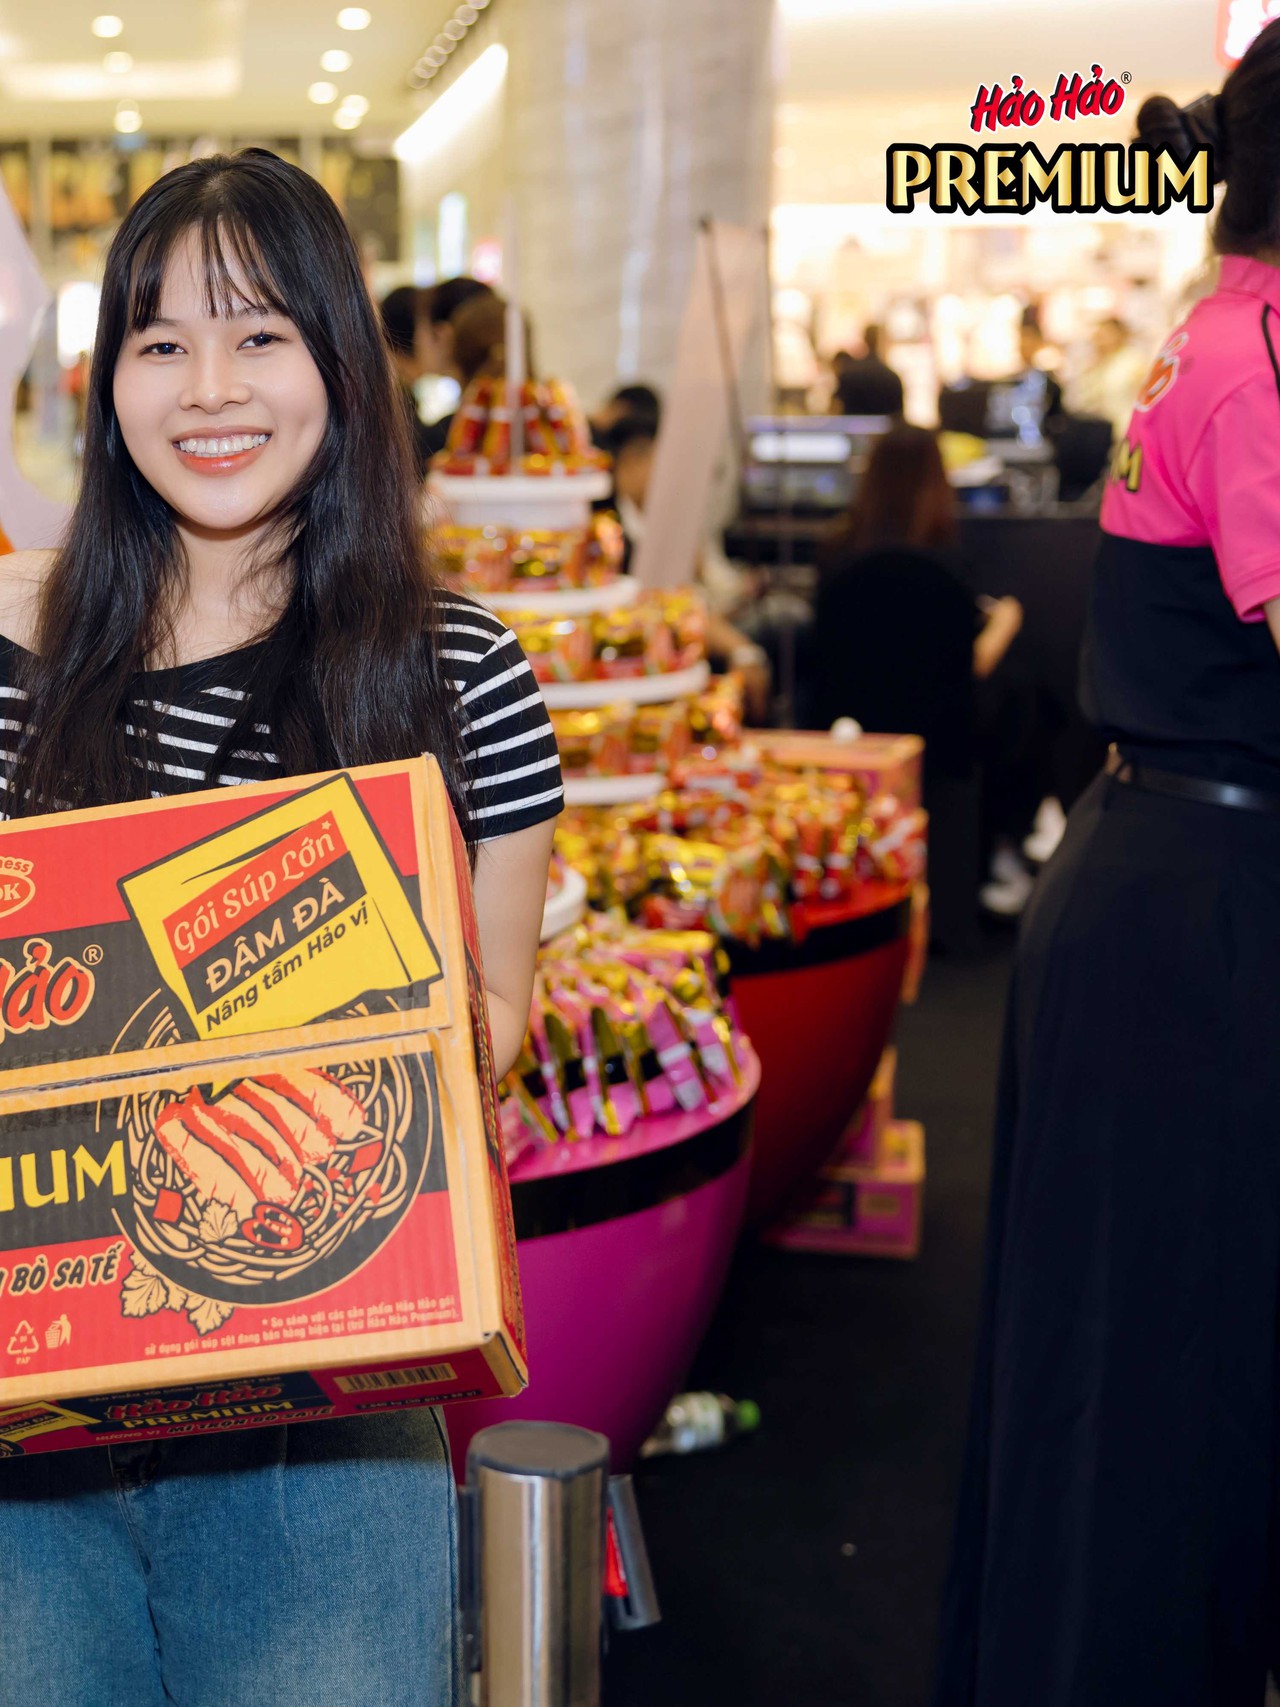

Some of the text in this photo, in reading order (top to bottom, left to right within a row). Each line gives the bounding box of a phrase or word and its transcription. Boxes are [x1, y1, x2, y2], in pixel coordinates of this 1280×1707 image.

[174, 833, 336, 954] Gói Súp Lớn
[205, 877, 346, 994] ĐẬM ĐÀ
[206, 900, 369, 1033] Nâng tầm Hảo vị
[10, 1255, 48, 1294] BÒ
[123, 1401, 294, 1429] PREMIUM
